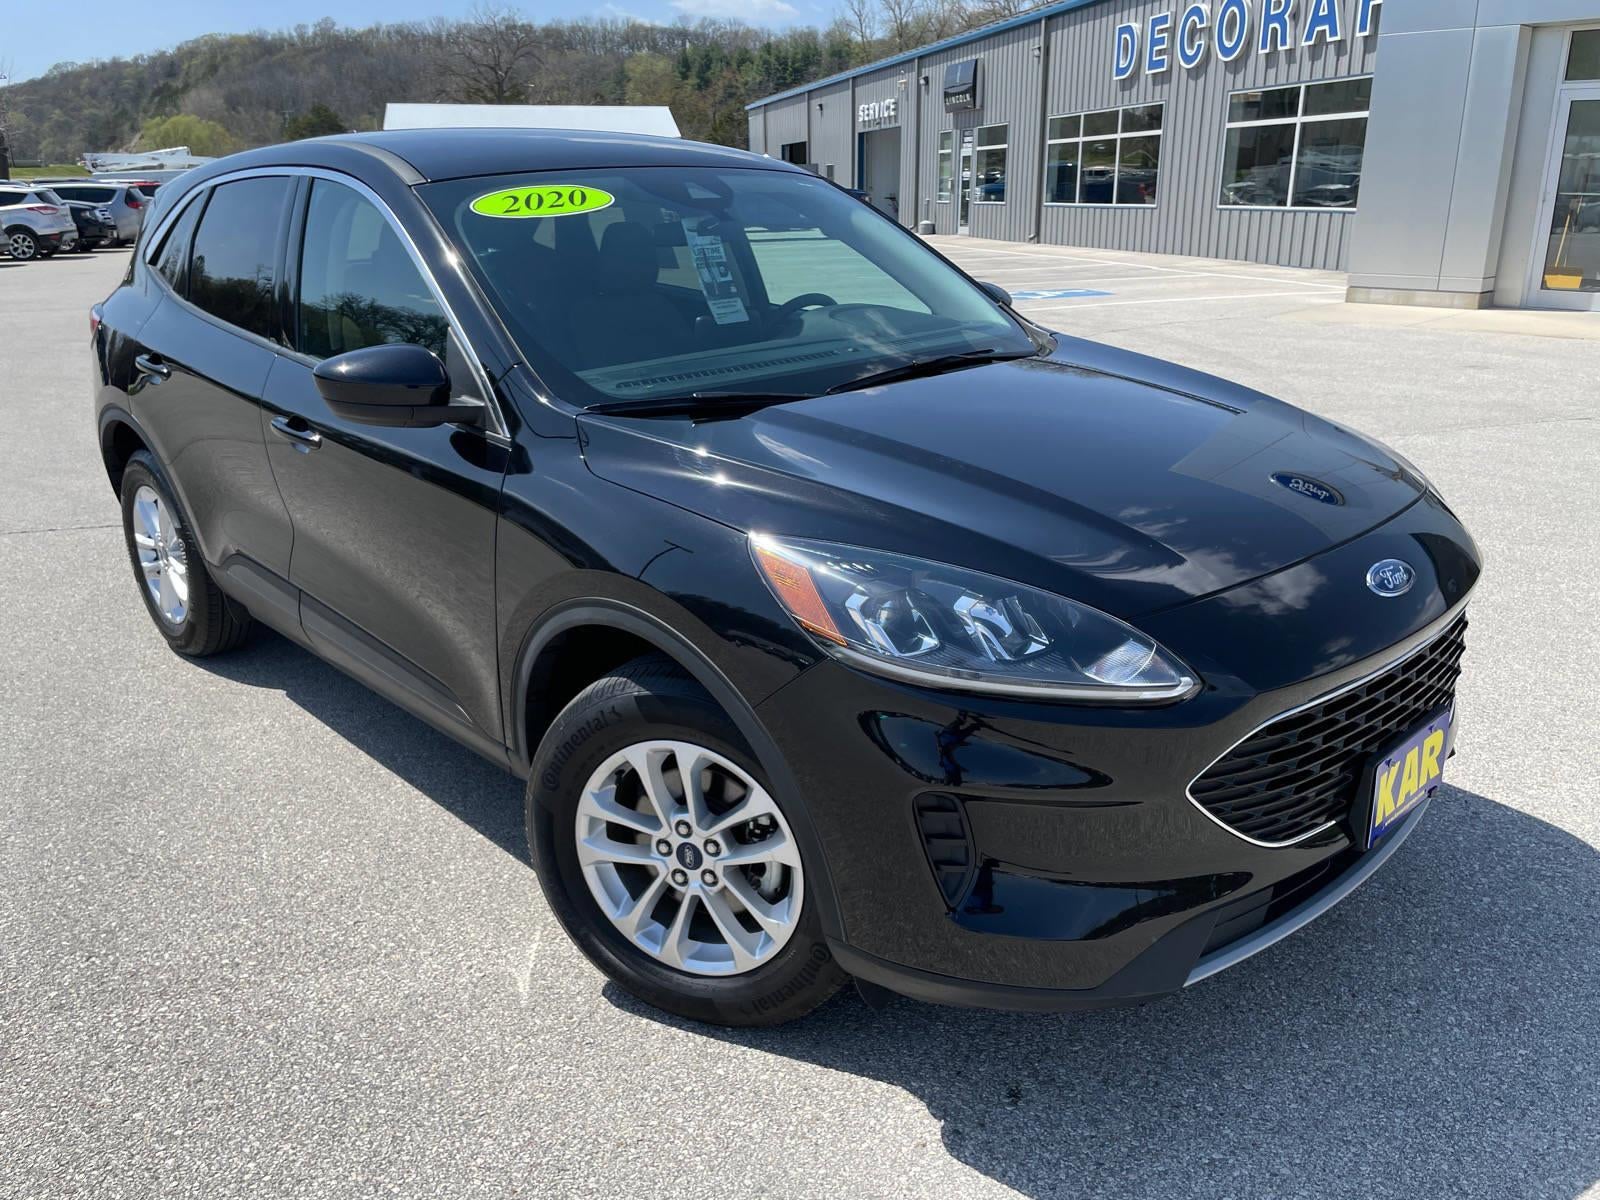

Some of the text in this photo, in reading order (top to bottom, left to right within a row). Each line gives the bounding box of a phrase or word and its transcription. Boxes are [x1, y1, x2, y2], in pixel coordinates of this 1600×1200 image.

[858, 99, 897, 122] SERVICE
[946, 94, 971, 105] LINCOLN
[502, 189, 587, 214] 2020
[1379, 565, 1409, 589] Ford
[542, 709, 609, 792] Continental
[1375, 729, 1444, 828] KAR
